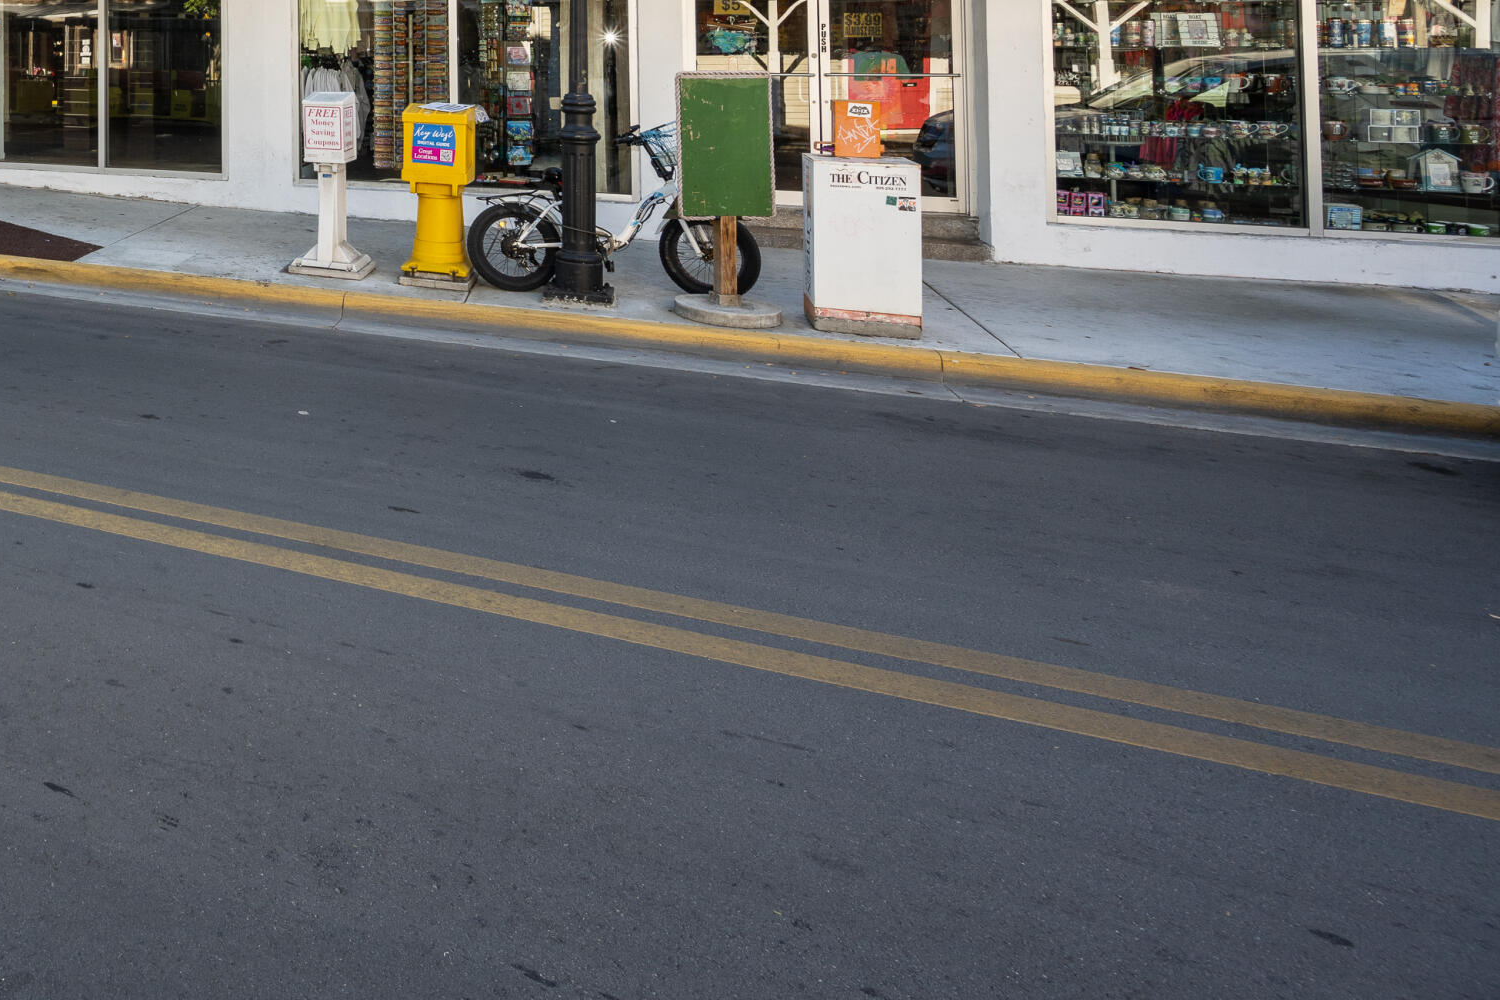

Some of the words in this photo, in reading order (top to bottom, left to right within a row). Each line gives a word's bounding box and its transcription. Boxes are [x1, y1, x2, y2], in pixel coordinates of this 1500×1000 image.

[844, 14, 882, 26] $3.99
[308, 108, 339, 119] FREE
[310, 119, 335, 128] Money
[310, 128, 336, 137] Saving
[414, 125, 430, 141] Key
[432, 126, 453, 142] West
[307, 138, 339, 147] Coupons
[414, 153, 438, 161] Locations
[829, 173, 852, 183] THE
